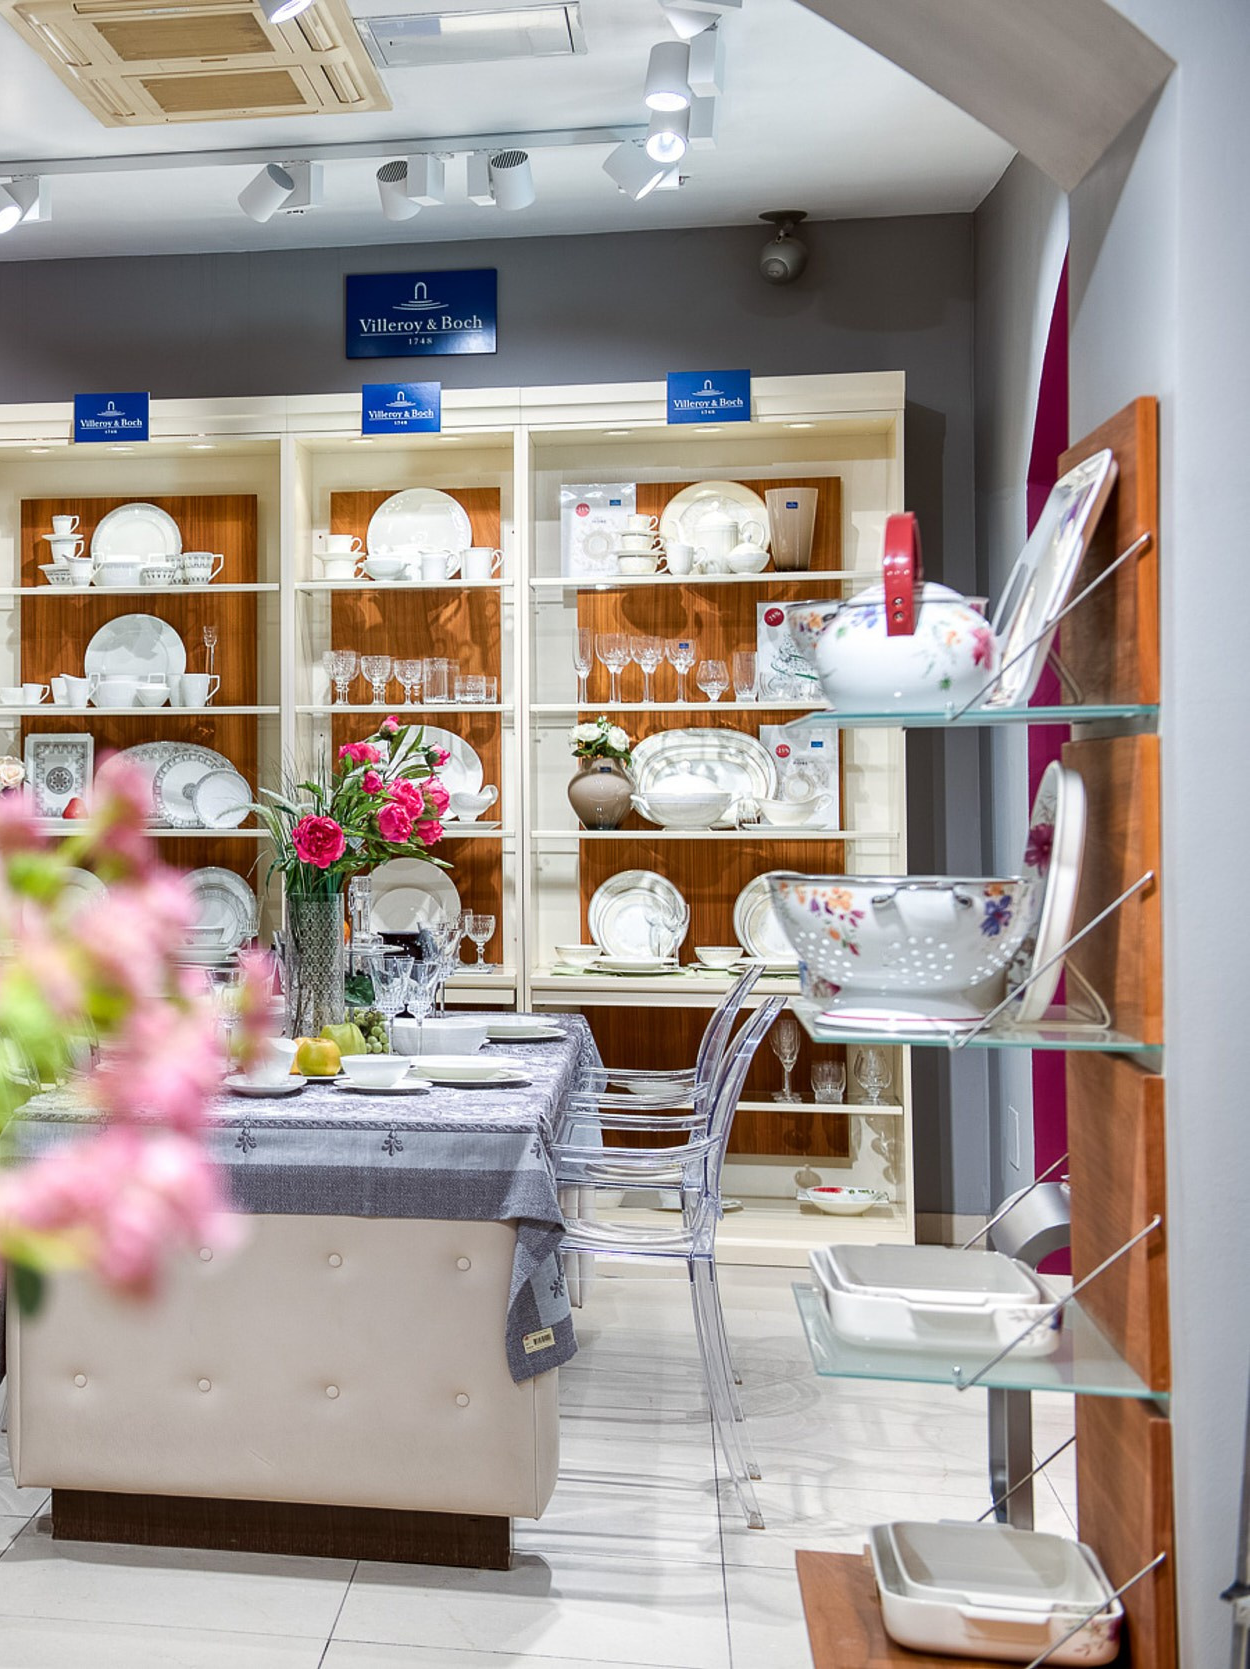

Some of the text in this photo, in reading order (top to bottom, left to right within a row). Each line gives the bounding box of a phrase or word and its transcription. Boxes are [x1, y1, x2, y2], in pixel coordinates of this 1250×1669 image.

[359, 315, 483, 334] Villeroy & Boch
[408, 337, 433, 345] 1748
[673, 399, 710, 409] Villeroy
[719, 397, 744, 407] Boch
[368, 410, 403, 419] Villeroy
[411, 409, 434, 418] Boch
[80, 418, 113, 428] Villeroy
[121, 418, 143, 426] Boch
